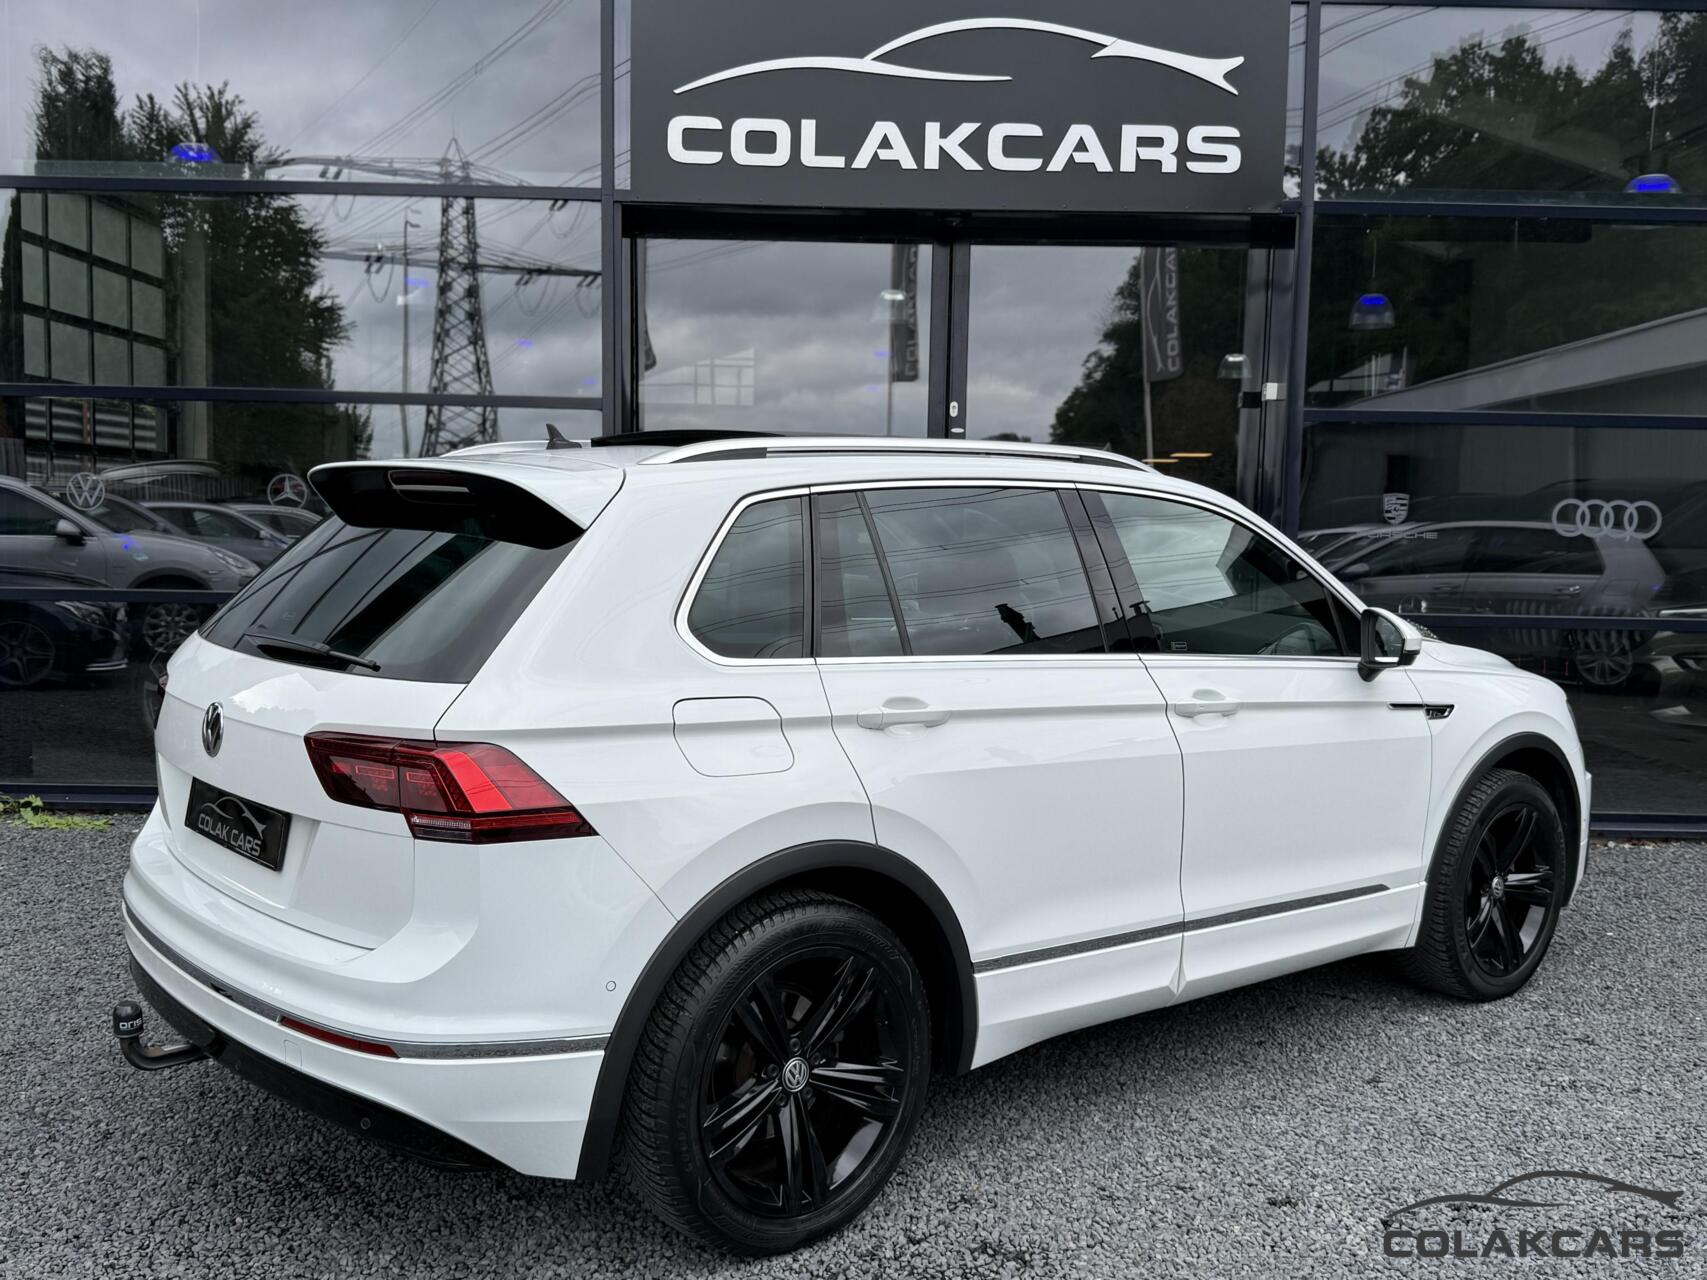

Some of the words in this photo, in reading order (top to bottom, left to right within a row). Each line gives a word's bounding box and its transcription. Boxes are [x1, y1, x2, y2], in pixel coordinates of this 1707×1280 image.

[667, 115, 1242, 174] COLAKCARS
[198, 813, 230, 842] COLAK
[230, 829, 262, 857] CARS
